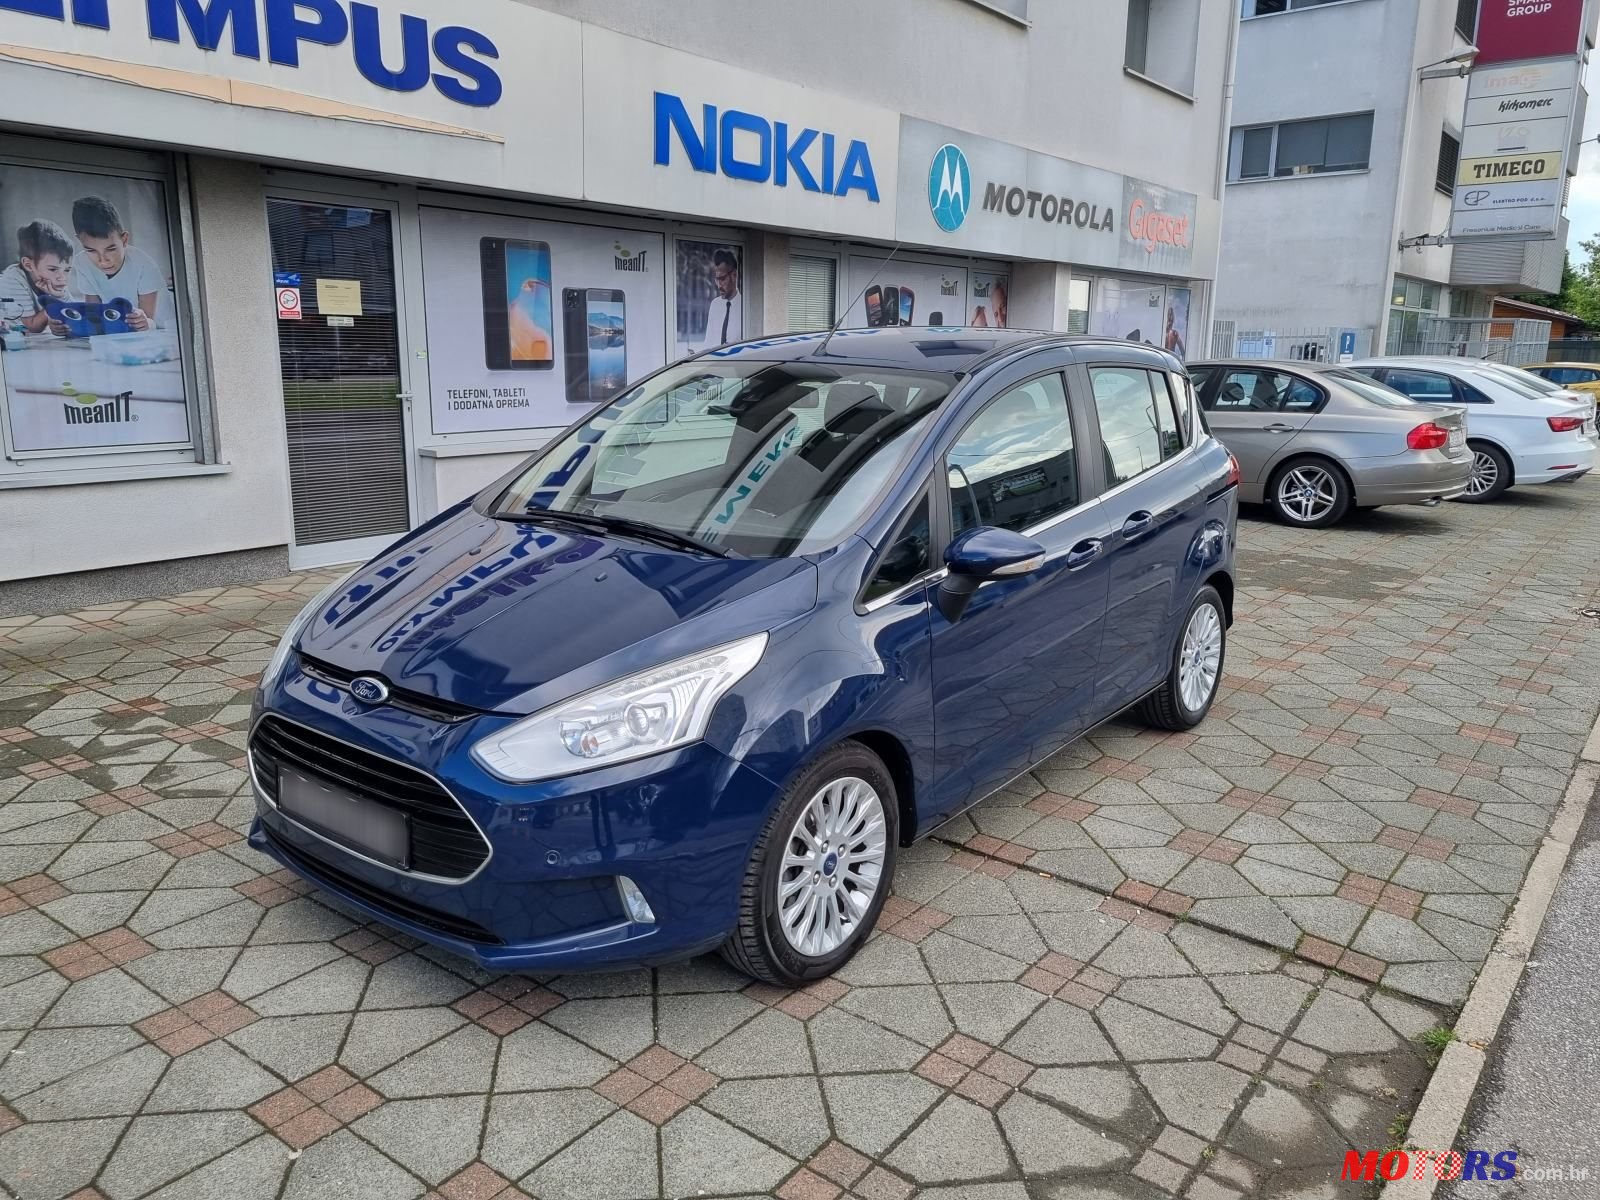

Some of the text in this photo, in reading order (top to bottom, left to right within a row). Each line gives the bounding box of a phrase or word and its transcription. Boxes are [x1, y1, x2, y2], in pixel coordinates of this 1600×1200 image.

[1507, 3, 1552, 17] GROUP
[1498, 98, 1554, 112] kirkomerc
[654, 91, 880, 203] NOKIA
[1474, 159, 1545, 178] TIMECO
[983, 181, 1114, 233] MOTOROLA
[1128, 198, 1188, 254] Gigaset
[615, 250, 647, 272] meanIT
[447, 388, 526, 399] TELEFONI, TABLETI
[64, 391, 133, 424] meanIT
[448, 399, 530, 410] I DODATNA OPREMA
[355, 681, 377, 698] Ford
